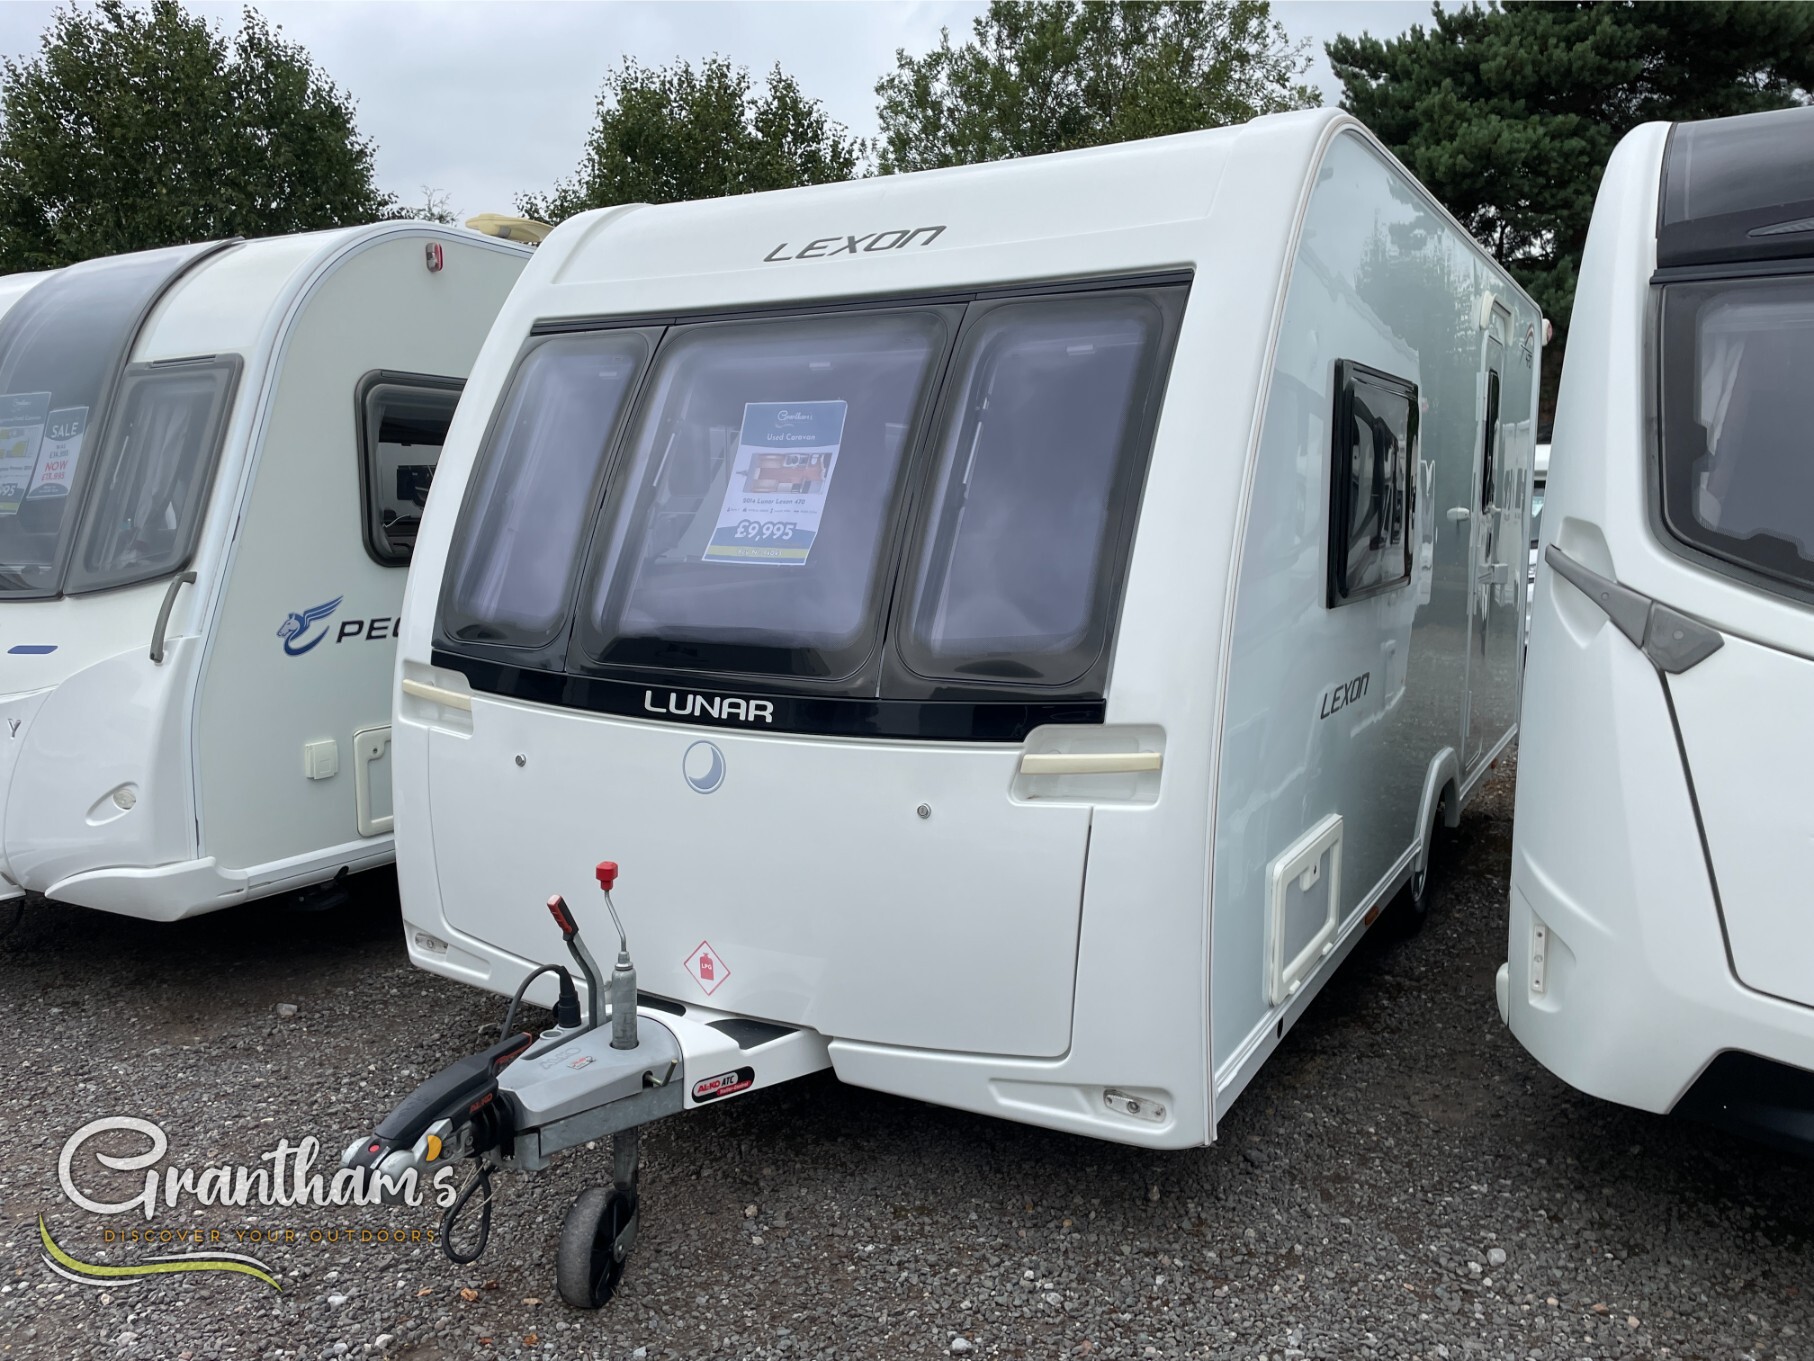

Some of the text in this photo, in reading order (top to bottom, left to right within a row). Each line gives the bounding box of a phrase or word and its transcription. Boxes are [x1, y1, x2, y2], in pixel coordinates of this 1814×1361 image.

[763, 225, 947, 263] LEXON
[51, 422, 79, 438] SALE
[767, 433, 816, 441] Used Caravan
[45, 461, 68, 473] NOW
[734, 521, 795, 541] £9,995
[1320, 671, 1370, 720] LEXON
[644, 690, 774, 723] LUNAR
[721, 1075, 735, 1087] ATC
